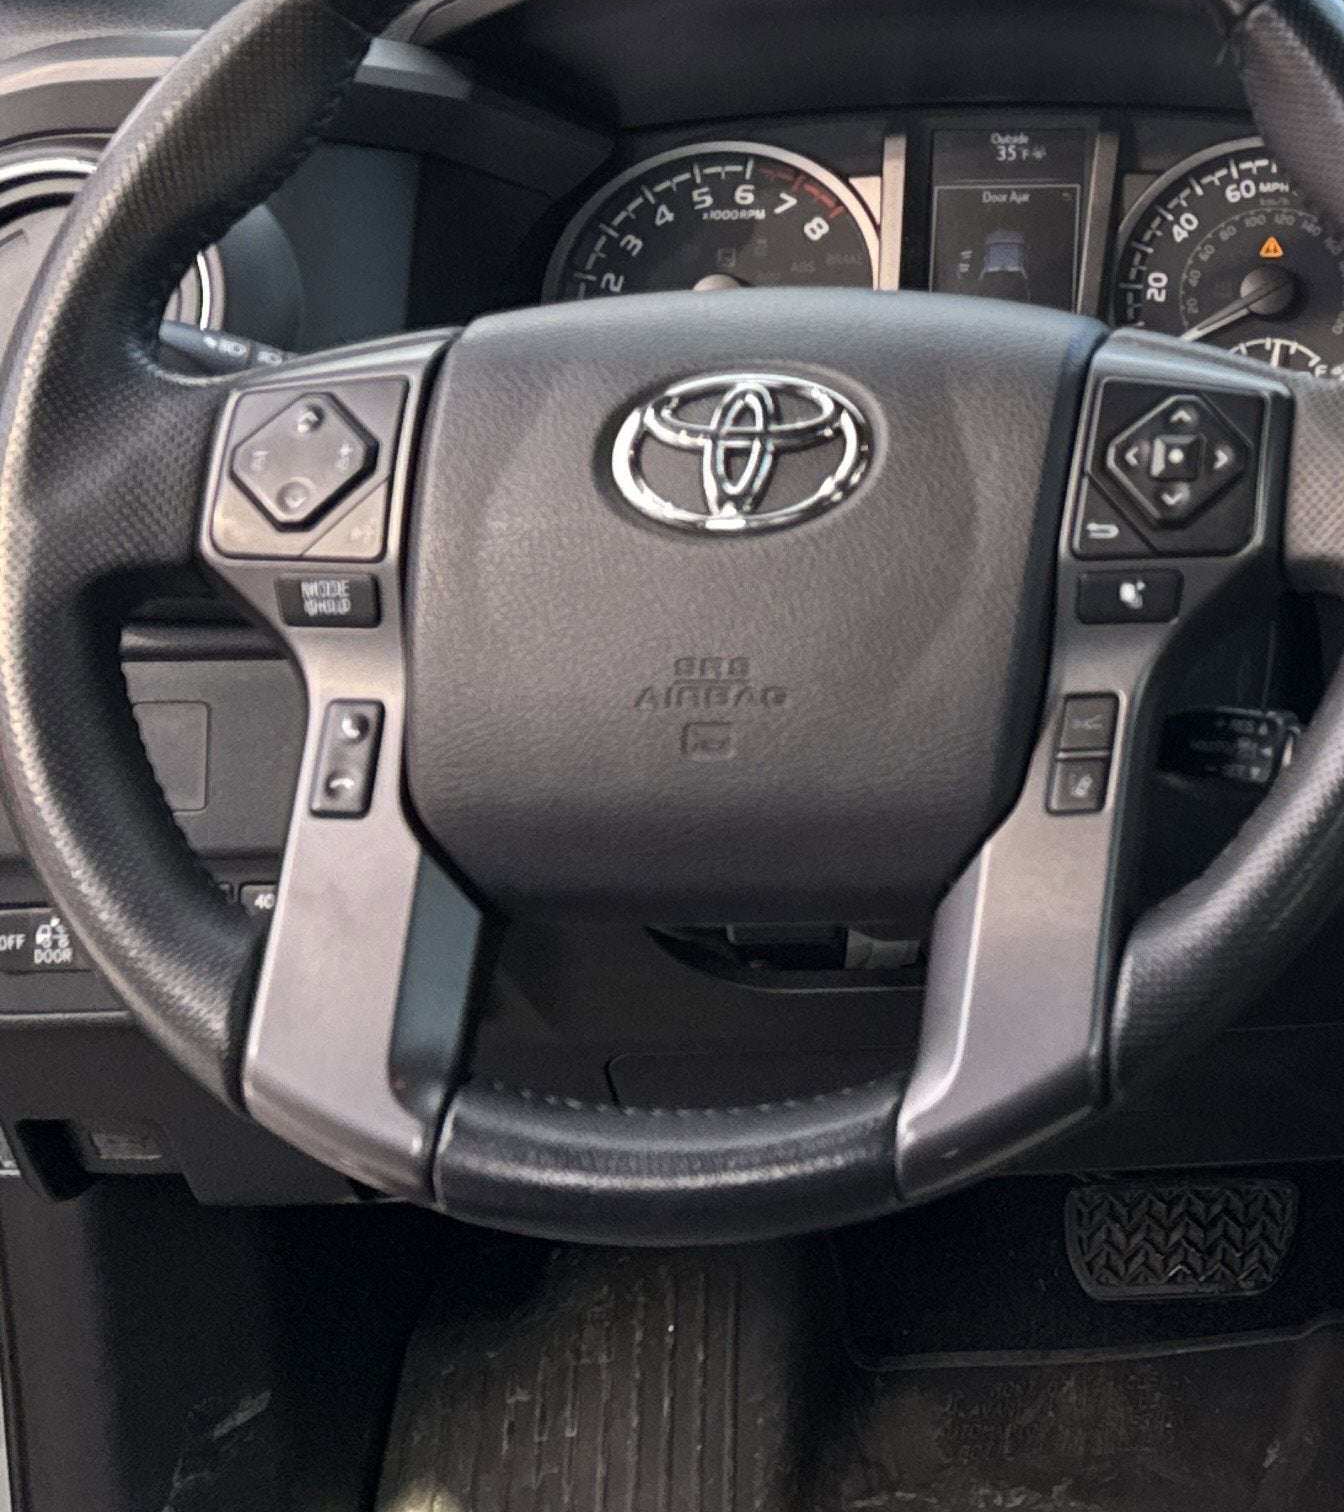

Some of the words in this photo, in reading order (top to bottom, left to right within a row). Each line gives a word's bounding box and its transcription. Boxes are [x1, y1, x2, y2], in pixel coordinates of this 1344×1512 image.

[990, 132, 1030, 145] Outside
[692, 186, 714, 210] 5
[734, 184, 756, 205] 6
[981, 191, 1008, 203] Door
[1009, 190, 1031, 204] Ajar
[1225, 179, 1257, 203] 60
[1259, 182, 1290, 194] MPH
[773, 192, 798, 214] 7
[654, 203, 675, 227] 4
[803, 216, 830, 242] 8
[1171, 212, 1200, 244] 40
[1218, 226, 1237, 241] 80
[1301, 220, 1322, 237] 140
[618, 234, 644, 258] 3
[1199, 244, 1215, 262] 60
[600, 272, 625, 292] 2
[1146, 272, 1168, 303] 20
[1188, 269, 1201, 287] 40
[1185, 297, 1199, 314] 20
[1314, 364, 1328, 377] F
[632, 685, 788, 709] AIRBAG
[34, 947, 73, 965] DOOR
